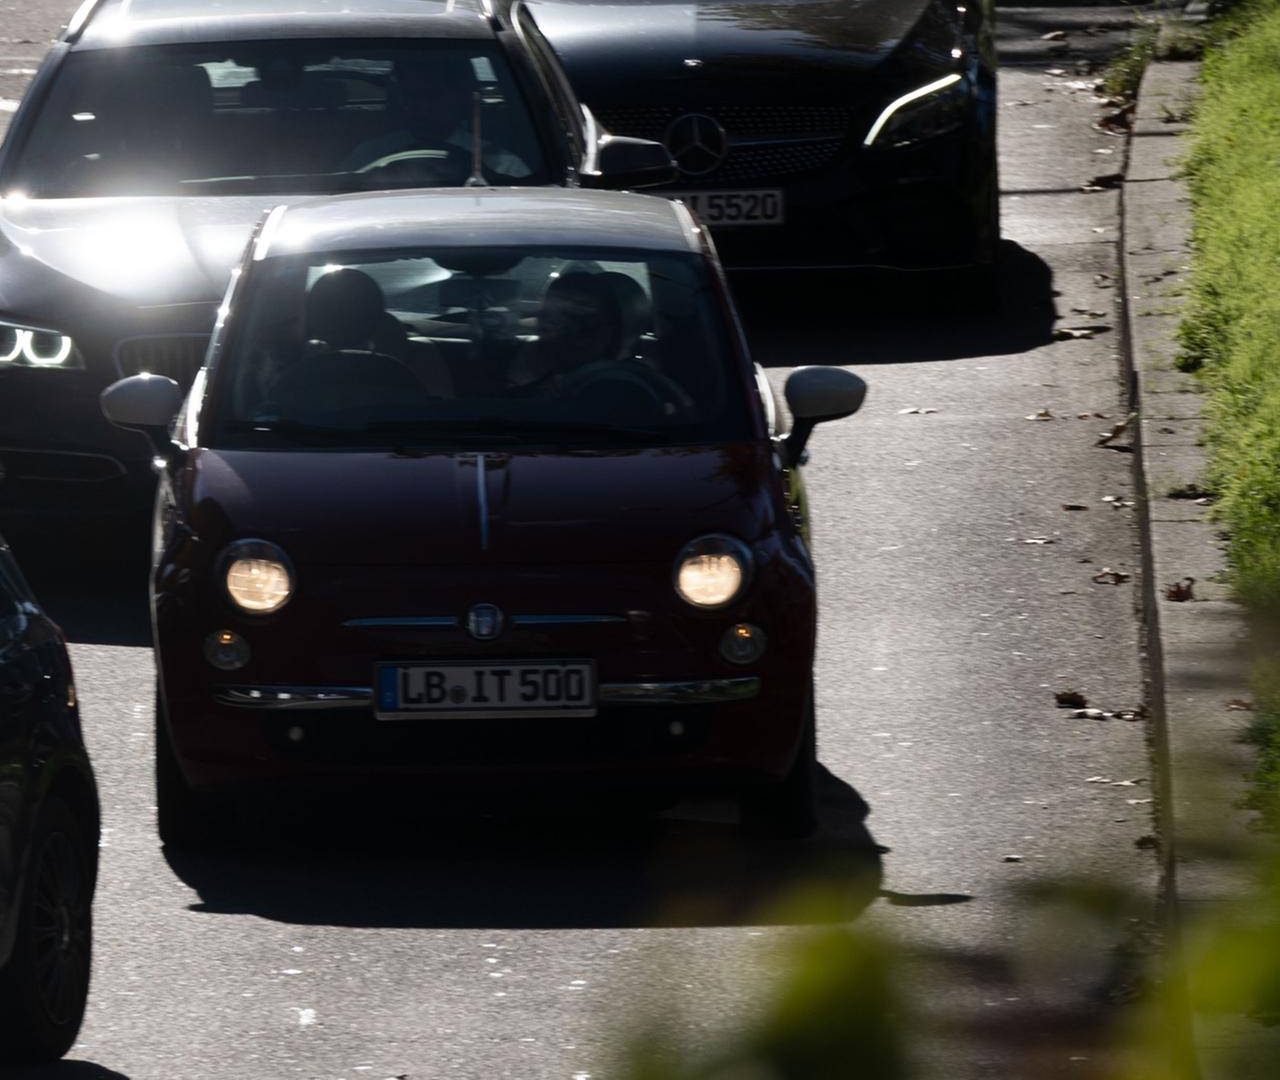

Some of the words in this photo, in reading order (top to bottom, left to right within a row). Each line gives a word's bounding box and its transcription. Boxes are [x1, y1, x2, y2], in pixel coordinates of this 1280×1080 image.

[707, 193, 779, 221] 5520
[401, 671, 447, 705] LB
[472, 670, 512, 703] IT
[520, 668, 585, 702] 500
